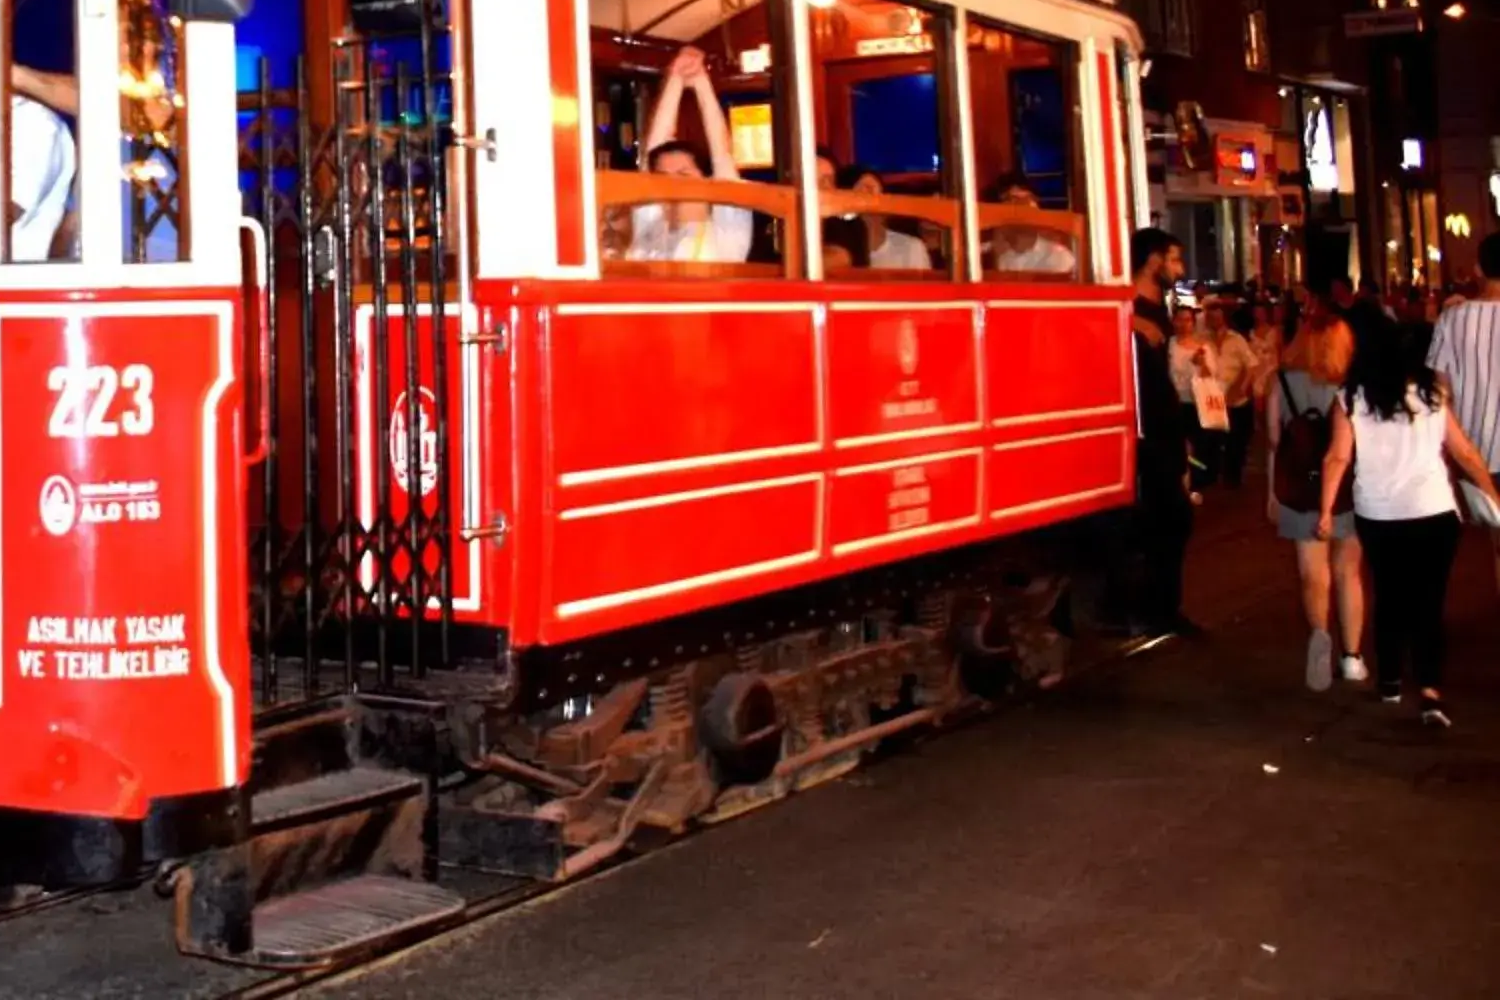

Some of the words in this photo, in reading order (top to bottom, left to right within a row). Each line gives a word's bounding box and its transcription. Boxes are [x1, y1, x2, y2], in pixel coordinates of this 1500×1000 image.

[47, 363, 155, 438] 223
[79, 501, 123, 522] ALO
[27, 616, 117, 644] ASILMAK
[125, 614, 186, 643] YASAK
[18, 650, 46, 678] VE
